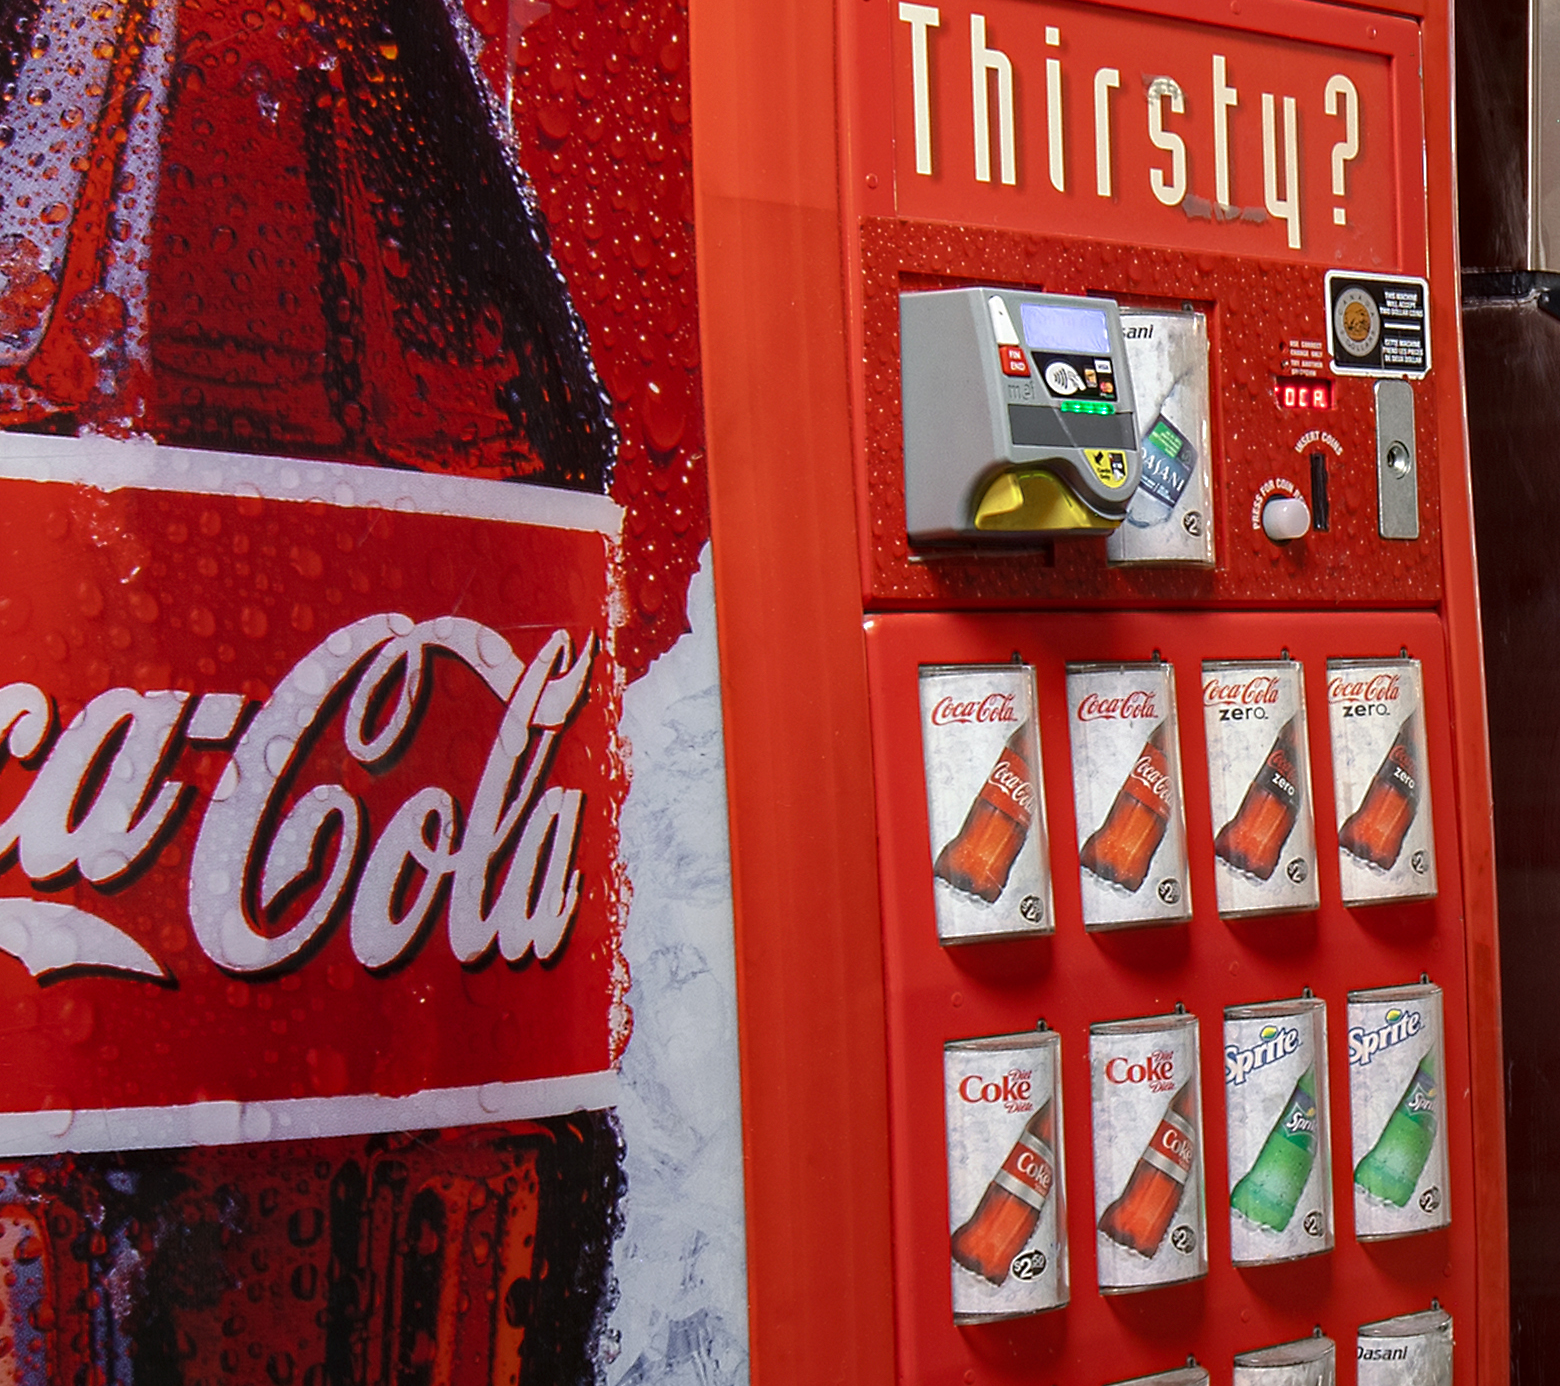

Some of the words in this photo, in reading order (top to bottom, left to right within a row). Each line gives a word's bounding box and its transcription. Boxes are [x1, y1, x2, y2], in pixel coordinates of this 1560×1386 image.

[899, 2, 1359, 249] Thirsty?
[1009, 350, 1022, 359] FIN
[1011, 361, 1026, 371] END
[1252, 494, 1263, 531] PRESS
[1260, 479, 1275, 497] FOR
[1204, 676, 1280, 707] Coca-Cola
[1328, 674, 1400, 704] Coca-Cola
[932, 693, 1017, 726] Coca-Cola
[1078, 691, 1158, 722] Coca-Cola
[1219, 706, 1268, 721] zero
[1343, 703, 1390, 718] zero
[1272, 772, 1295, 796] zero
[1393, 767, 1416, 789] zero
[1348, 1010, 1422, 1066] Sprite
[1105, 1056, 1174, 1085] Coke
[1225, 1027, 1300, 1086] Sprite
[958, 1075, 1032, 1104] Coke
[1162, 1129, 1194, 1162] Coke
[1017, 1152, 1052, 1190] Coke
[1357, 1345, 1409, 1361] Dasani
